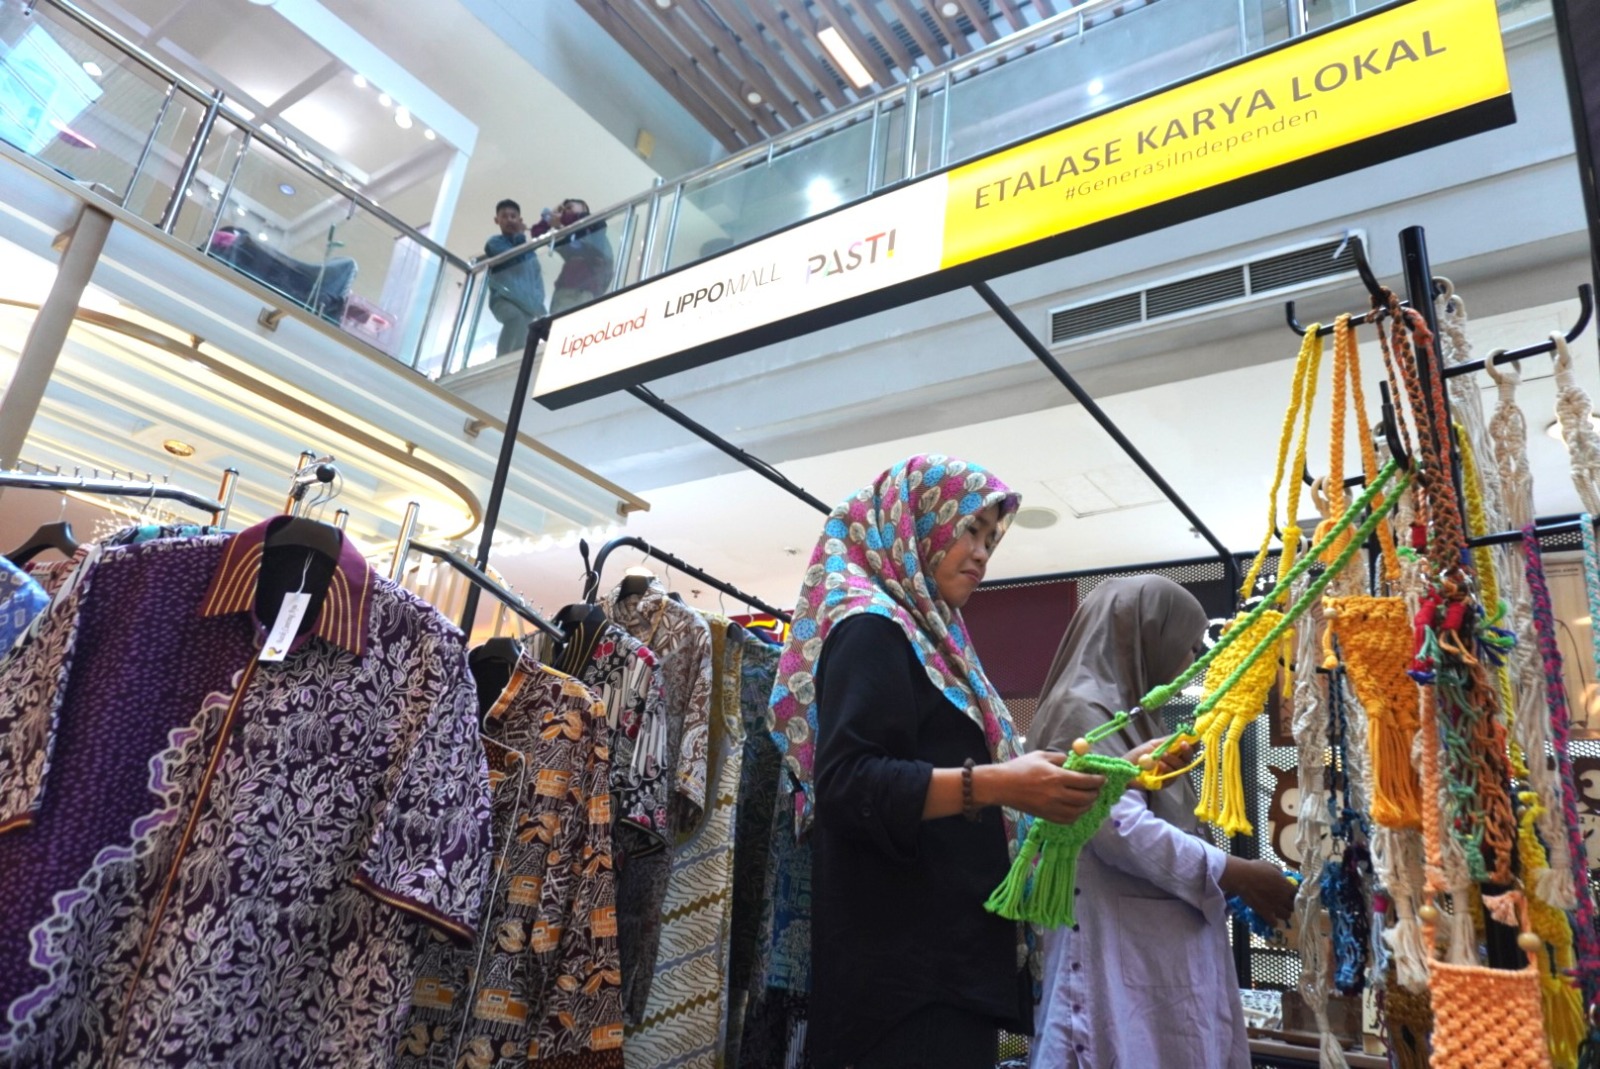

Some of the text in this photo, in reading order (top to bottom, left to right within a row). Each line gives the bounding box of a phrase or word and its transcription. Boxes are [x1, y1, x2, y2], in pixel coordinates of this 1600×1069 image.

[975, 30, 1447, 209] ETALASE KARYA LOKAL
[561, 307, 647, 357] LippoLand
